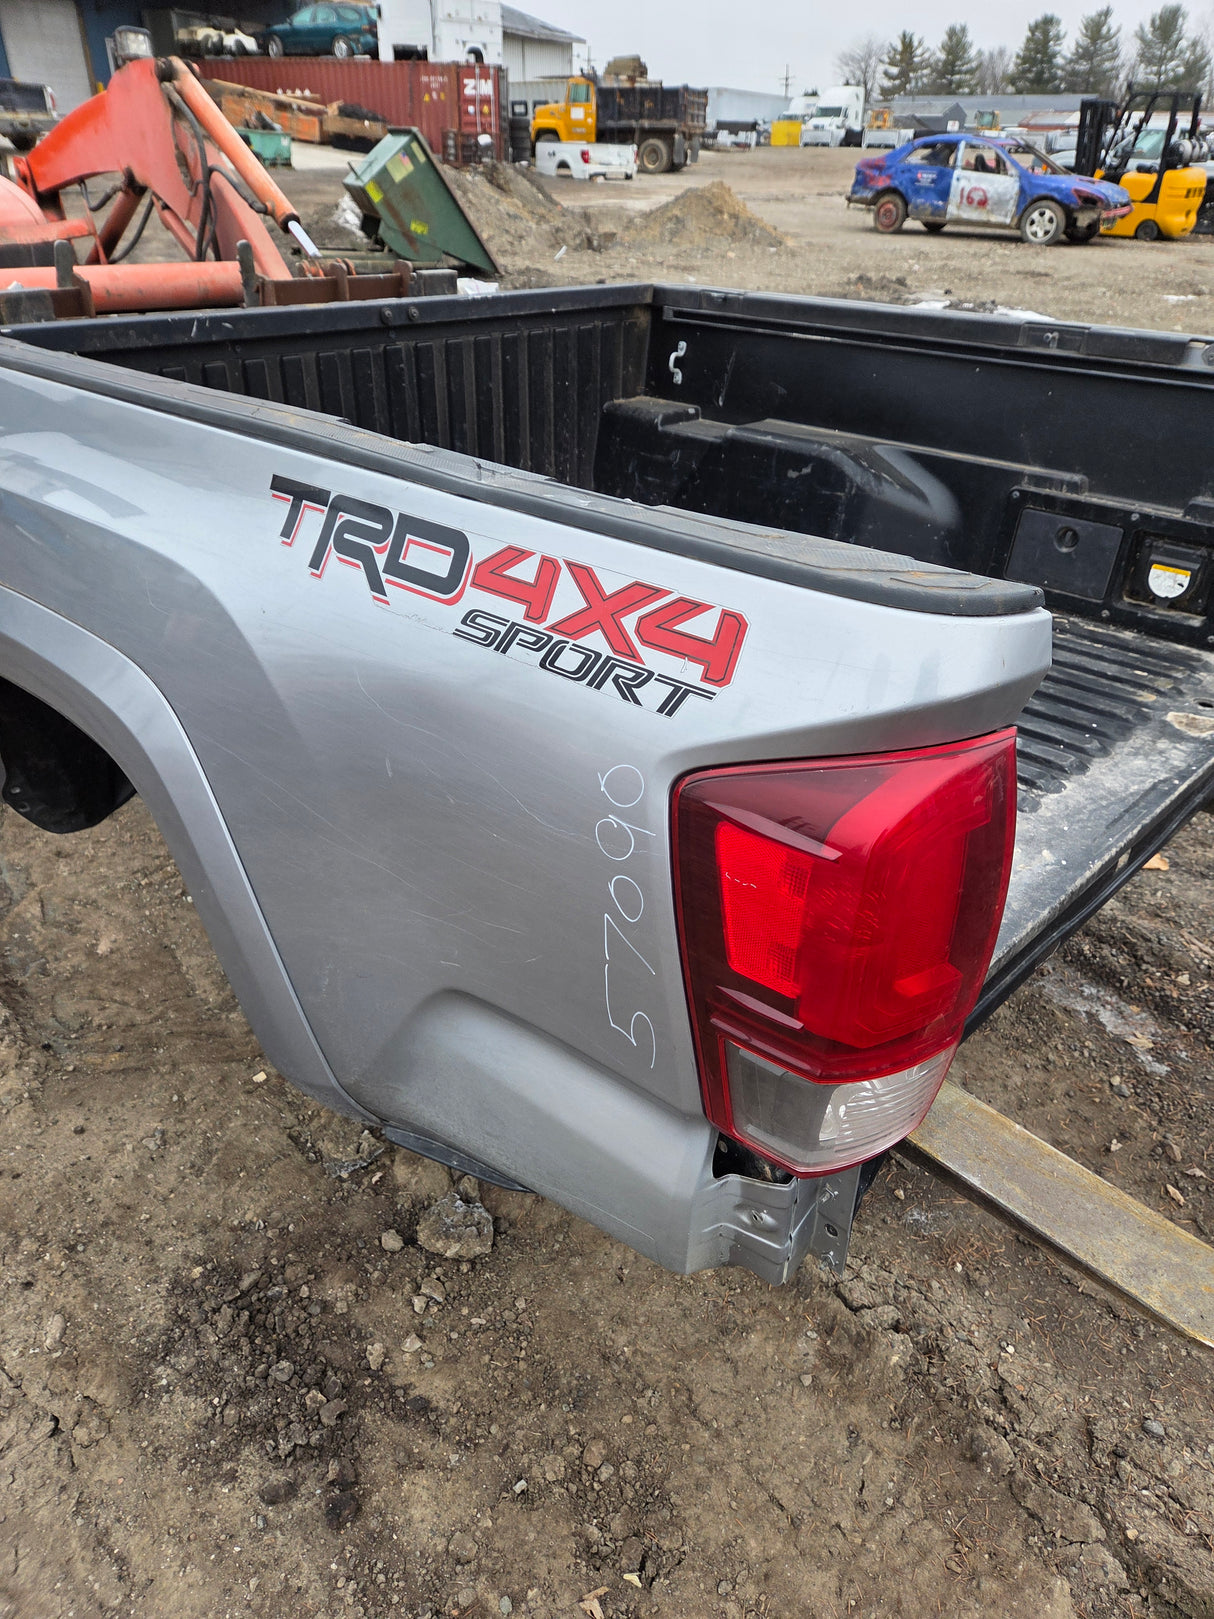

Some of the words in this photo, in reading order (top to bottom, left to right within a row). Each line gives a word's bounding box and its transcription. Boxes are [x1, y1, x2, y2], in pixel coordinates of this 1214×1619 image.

[463, 78, 493, 95] ZM
[269, 474, 473, 607] TRD
[453, 608, 717, 718] SPORT
[595, 764, 656, 1069] 57090
